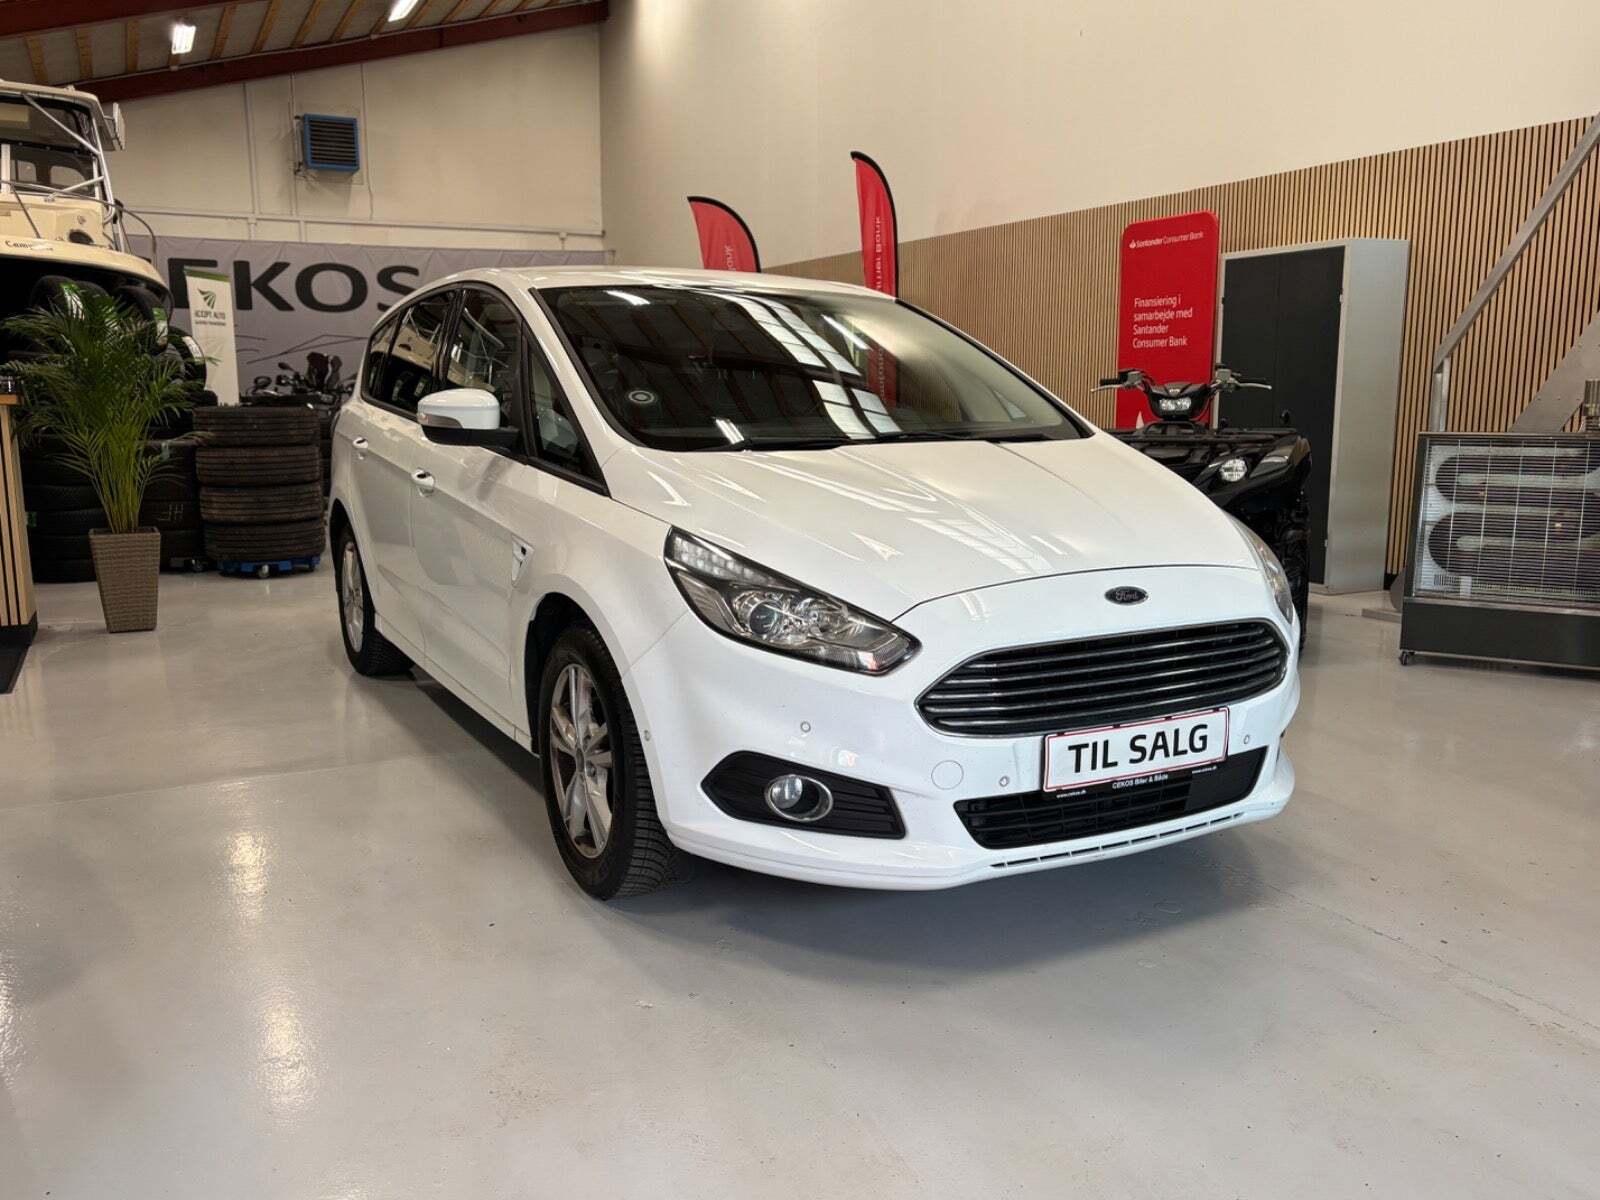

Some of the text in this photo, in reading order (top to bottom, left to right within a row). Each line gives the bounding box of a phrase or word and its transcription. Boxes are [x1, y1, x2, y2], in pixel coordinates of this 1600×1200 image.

[1136, 232, 1203, 248] Santander Consumer Bank
[1134, 295, 1177, 308] Finansiering
[1134, 307, 1193, 322] samarbejde med
[1133, 323, 1169, 335] Santander
[1133, 336, 1188, 348] Consumer Bank
[1068, 724, 1208, 773] TIL SALG
